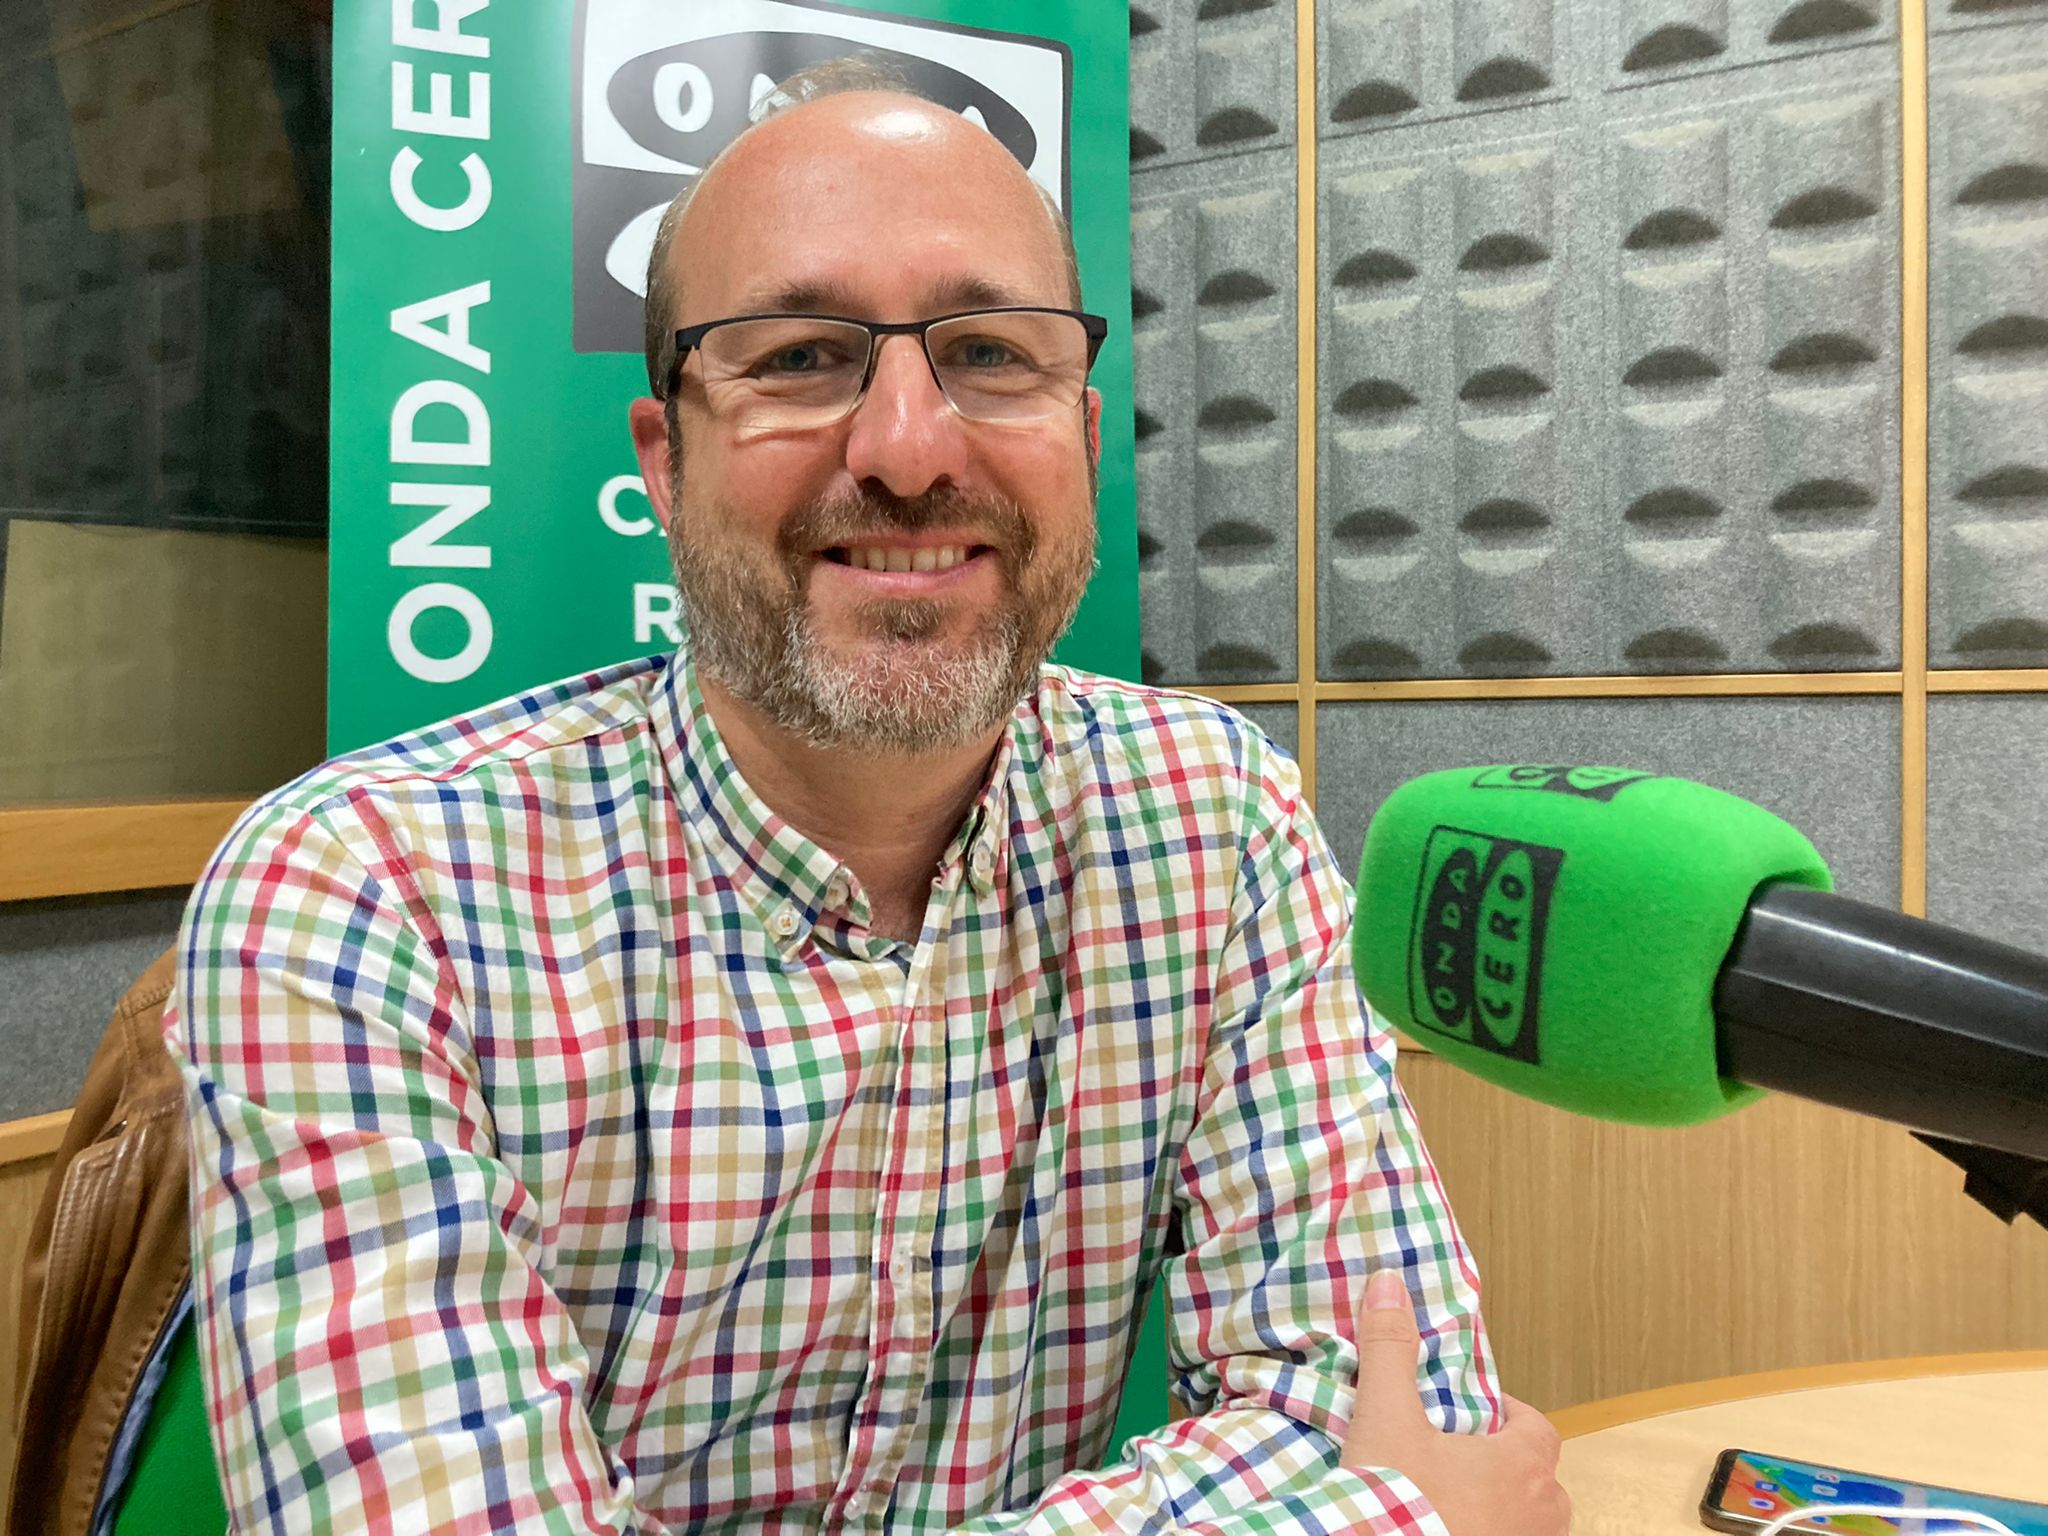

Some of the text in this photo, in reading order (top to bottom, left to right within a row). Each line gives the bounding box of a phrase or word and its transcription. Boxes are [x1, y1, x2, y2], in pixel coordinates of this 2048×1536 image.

[387, 280, 494, 684] ONDA
[1431, 867, 1470, 1011] ONDA
[1479, 873, 1526, 1020] CERO
